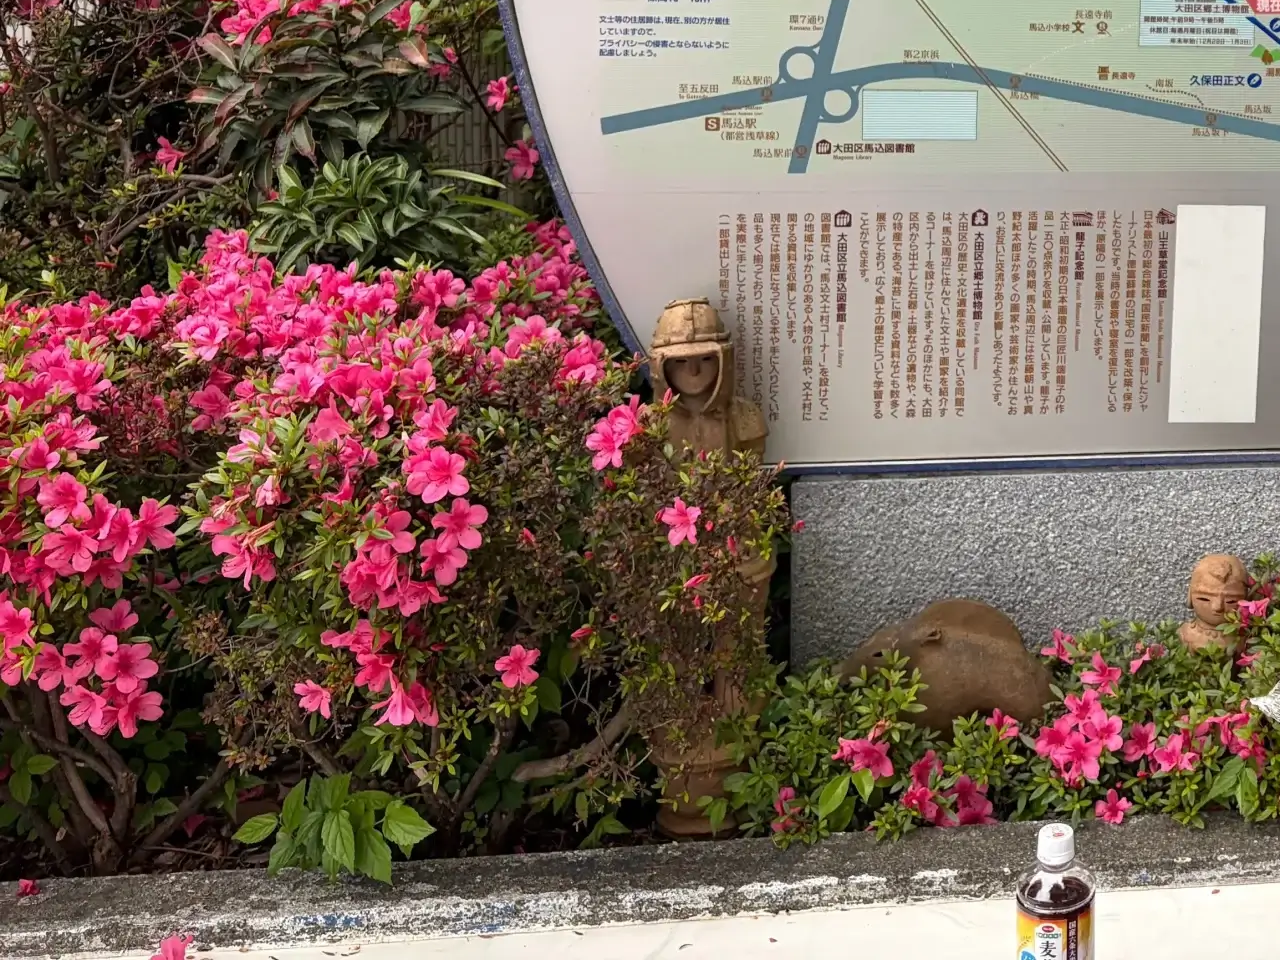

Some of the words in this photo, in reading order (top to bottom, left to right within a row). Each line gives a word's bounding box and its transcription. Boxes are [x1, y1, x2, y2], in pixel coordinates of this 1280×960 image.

[1175, 3, 1249, 14] 大田区郷土博物館
[789, 14, 824, 25] 環7通り
[903, 49, 939, 60] 第2京浜
[1190, 75, 1245, 87] 久保田正文
[722, 118, 757, 129] 馬込駅
[833, 143, 914, 155] 大田区馬込図書館
[859, 212, 869, 282] ことができます。
[1158, 231, 1168, 298] 山王草堂記念館
[787, 213, 798, 343] 関する資料を収集しています。
[837, 233, 847, 322] 大田区立馬込図書館
[973, 232, 984, 320] 大田区立郷土博物館
